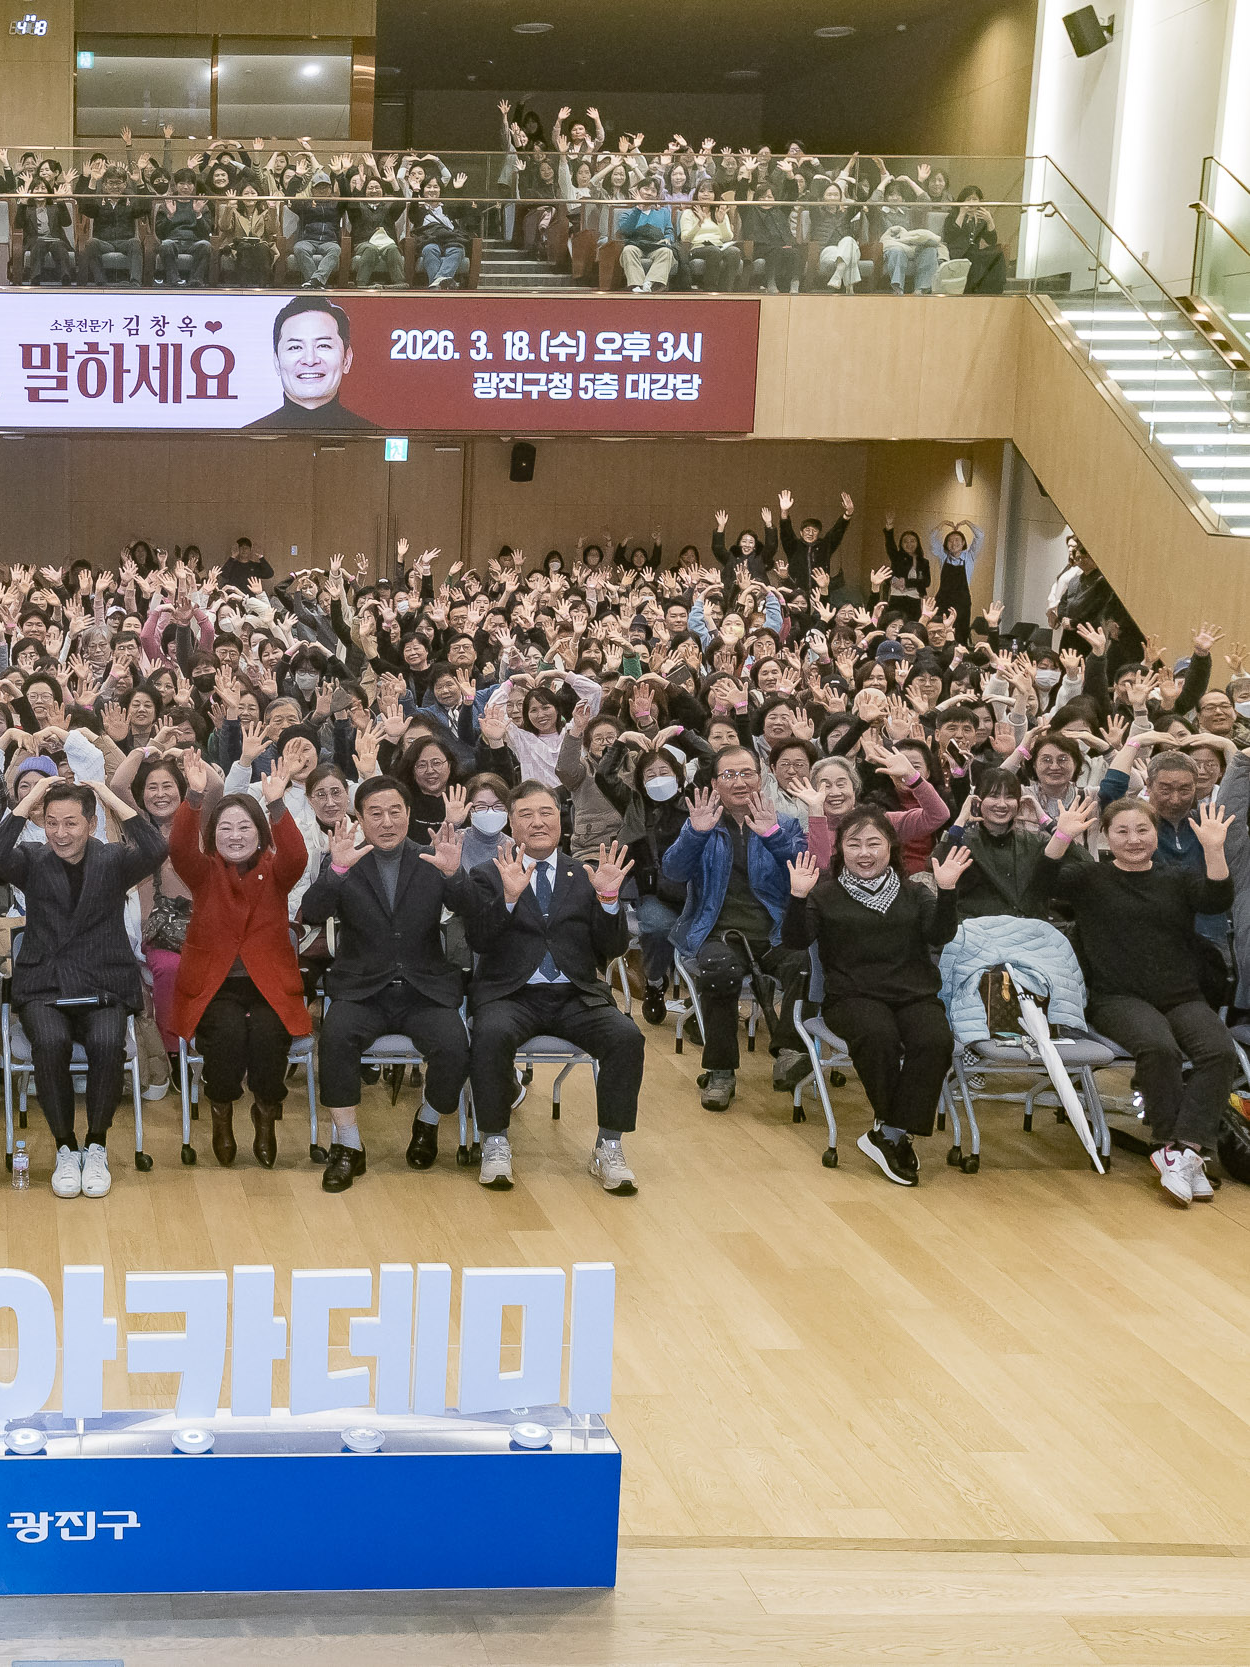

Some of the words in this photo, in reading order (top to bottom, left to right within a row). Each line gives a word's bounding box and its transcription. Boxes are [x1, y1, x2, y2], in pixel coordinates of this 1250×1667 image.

[50, 319, 114, 334] 소통전문가
[391, 330, 460, 361] 2026.
[470, 331, 493, 361] 3.
[594, 331, 650, 362] 오후
[657, 332, 702, 362] 3시
[19, 342, 238, 404] 말하세요
[473, 373, 572, 399] 광진구청
[579, 373, 618, 399] 5층
[626, 374, 701, 400] 대강당
[7, 1511, 141, 1543] 광진구
